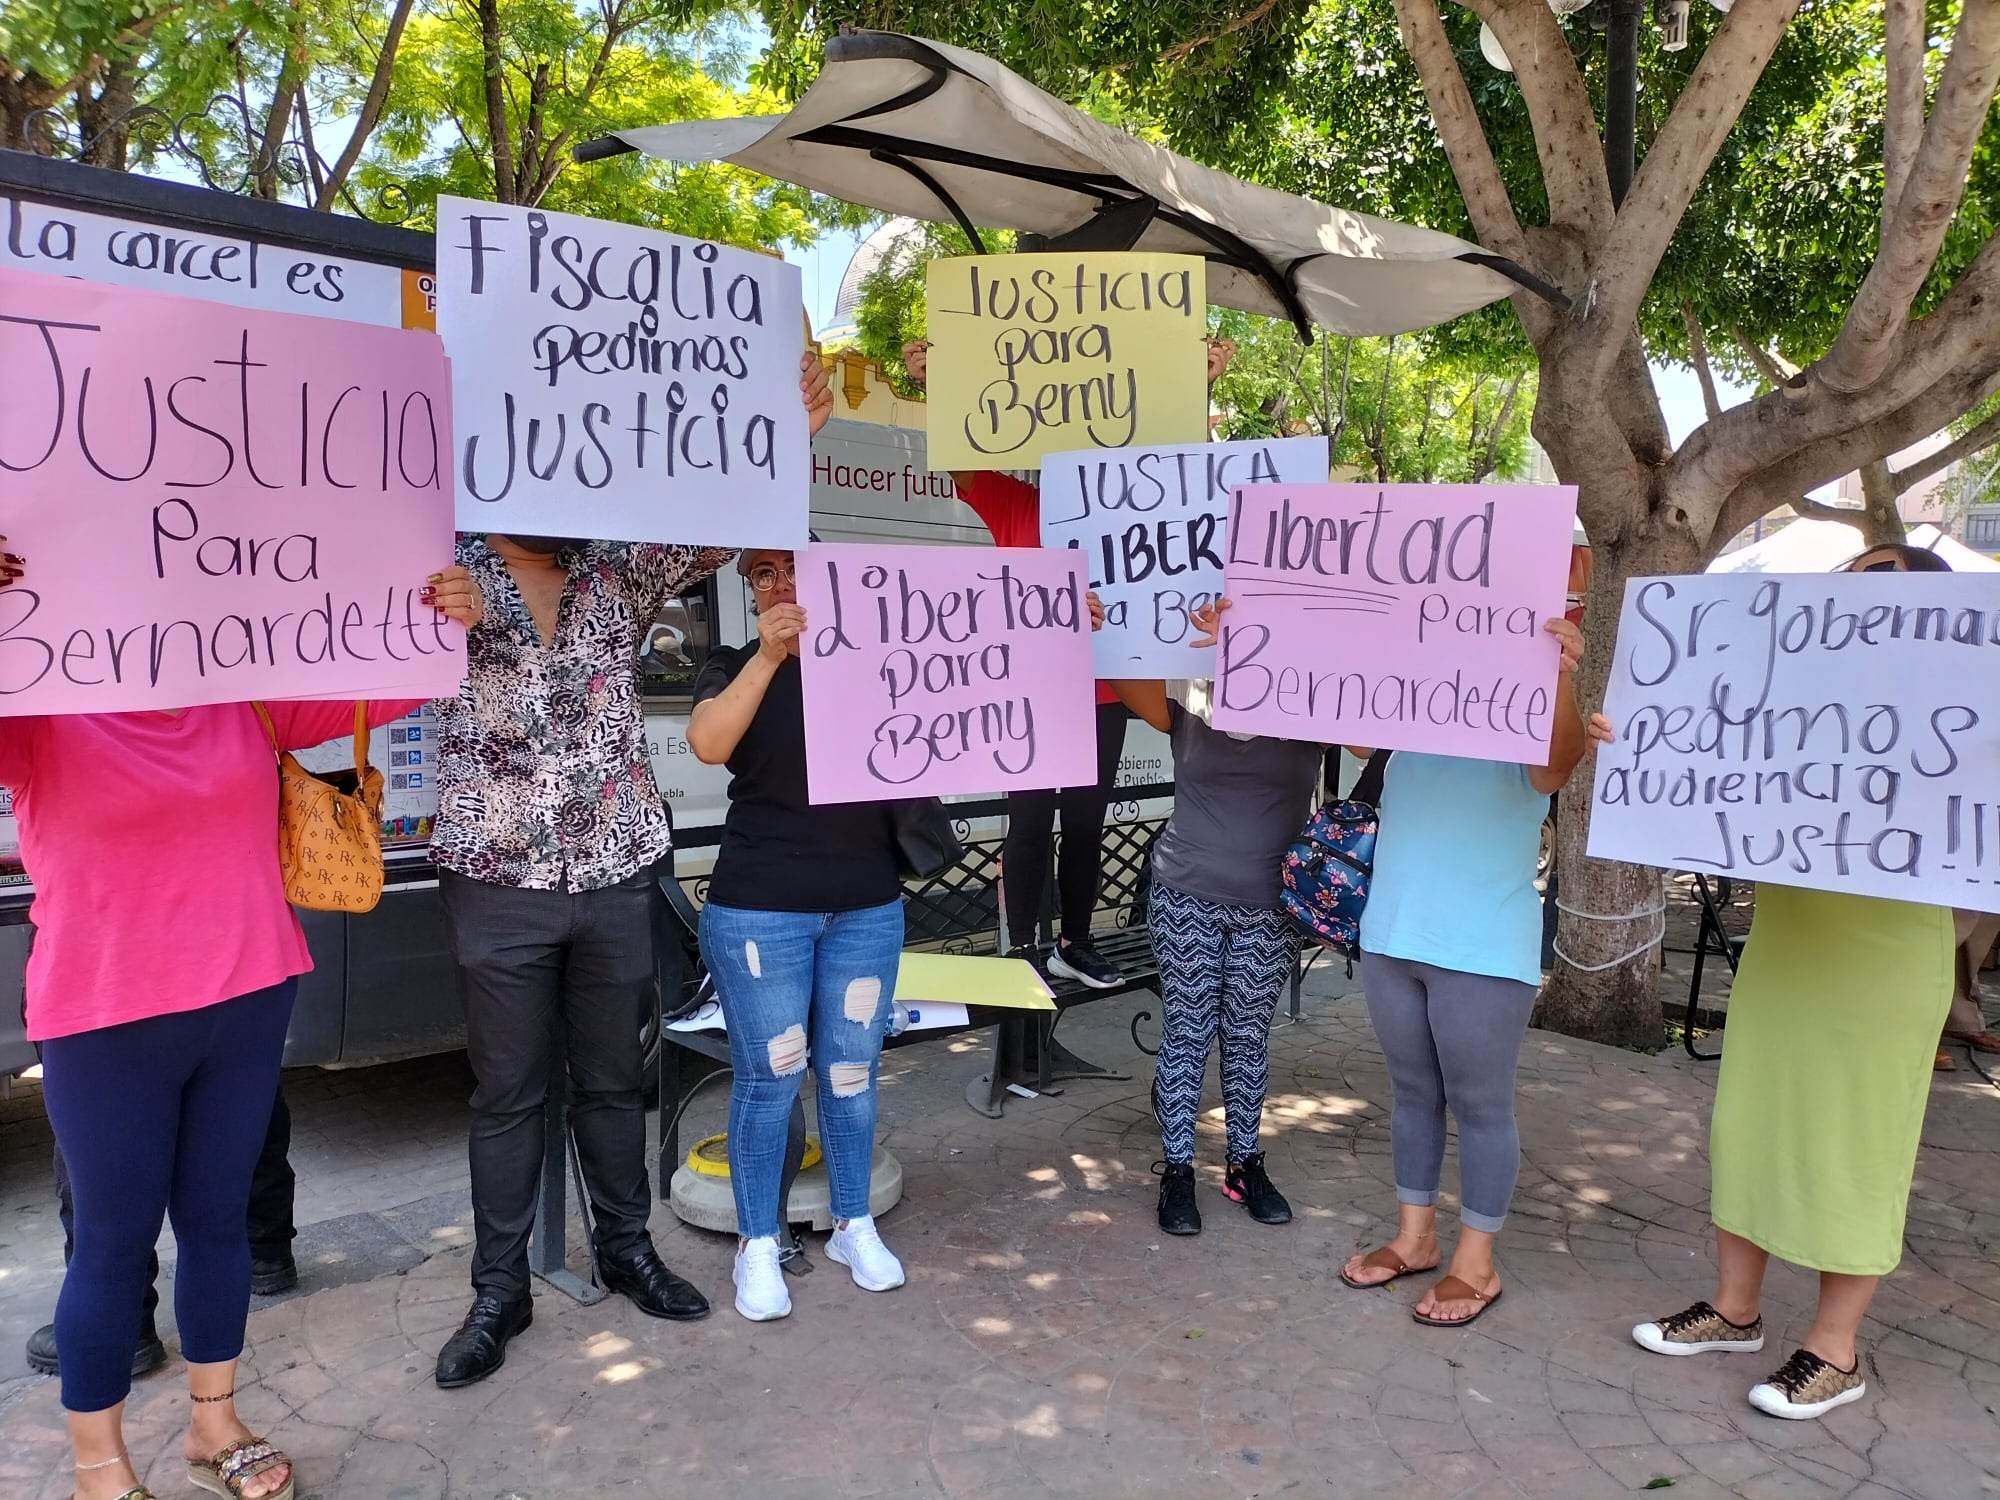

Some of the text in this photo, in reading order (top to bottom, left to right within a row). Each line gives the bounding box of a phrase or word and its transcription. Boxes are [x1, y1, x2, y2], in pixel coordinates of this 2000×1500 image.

[108, 230, 258, 288] carcel
[286, 262, 345, 301] es
[454, 212, 763, 325] Fiscalia
[939, 263, 1192, 323] Justicia
[0, 316, 441, 491] Justicia
[463, 381, 776, 502] Justicia
[964, 368, 1137, 454] Berny
[812, 453, 896, 492] Hacer
[1229, 490, 1495, 588] Libertad
[814, 561, 1080, 657] Libertad
[1630, 581, 1731, 686] Sr.
[1220, 624, 1548, 741] Bernardette
[866, 697, 1036, 784] Berny
[1622, 683, 1980, 778] pedimos
[1600, 762, 1902, 823] audiencia
